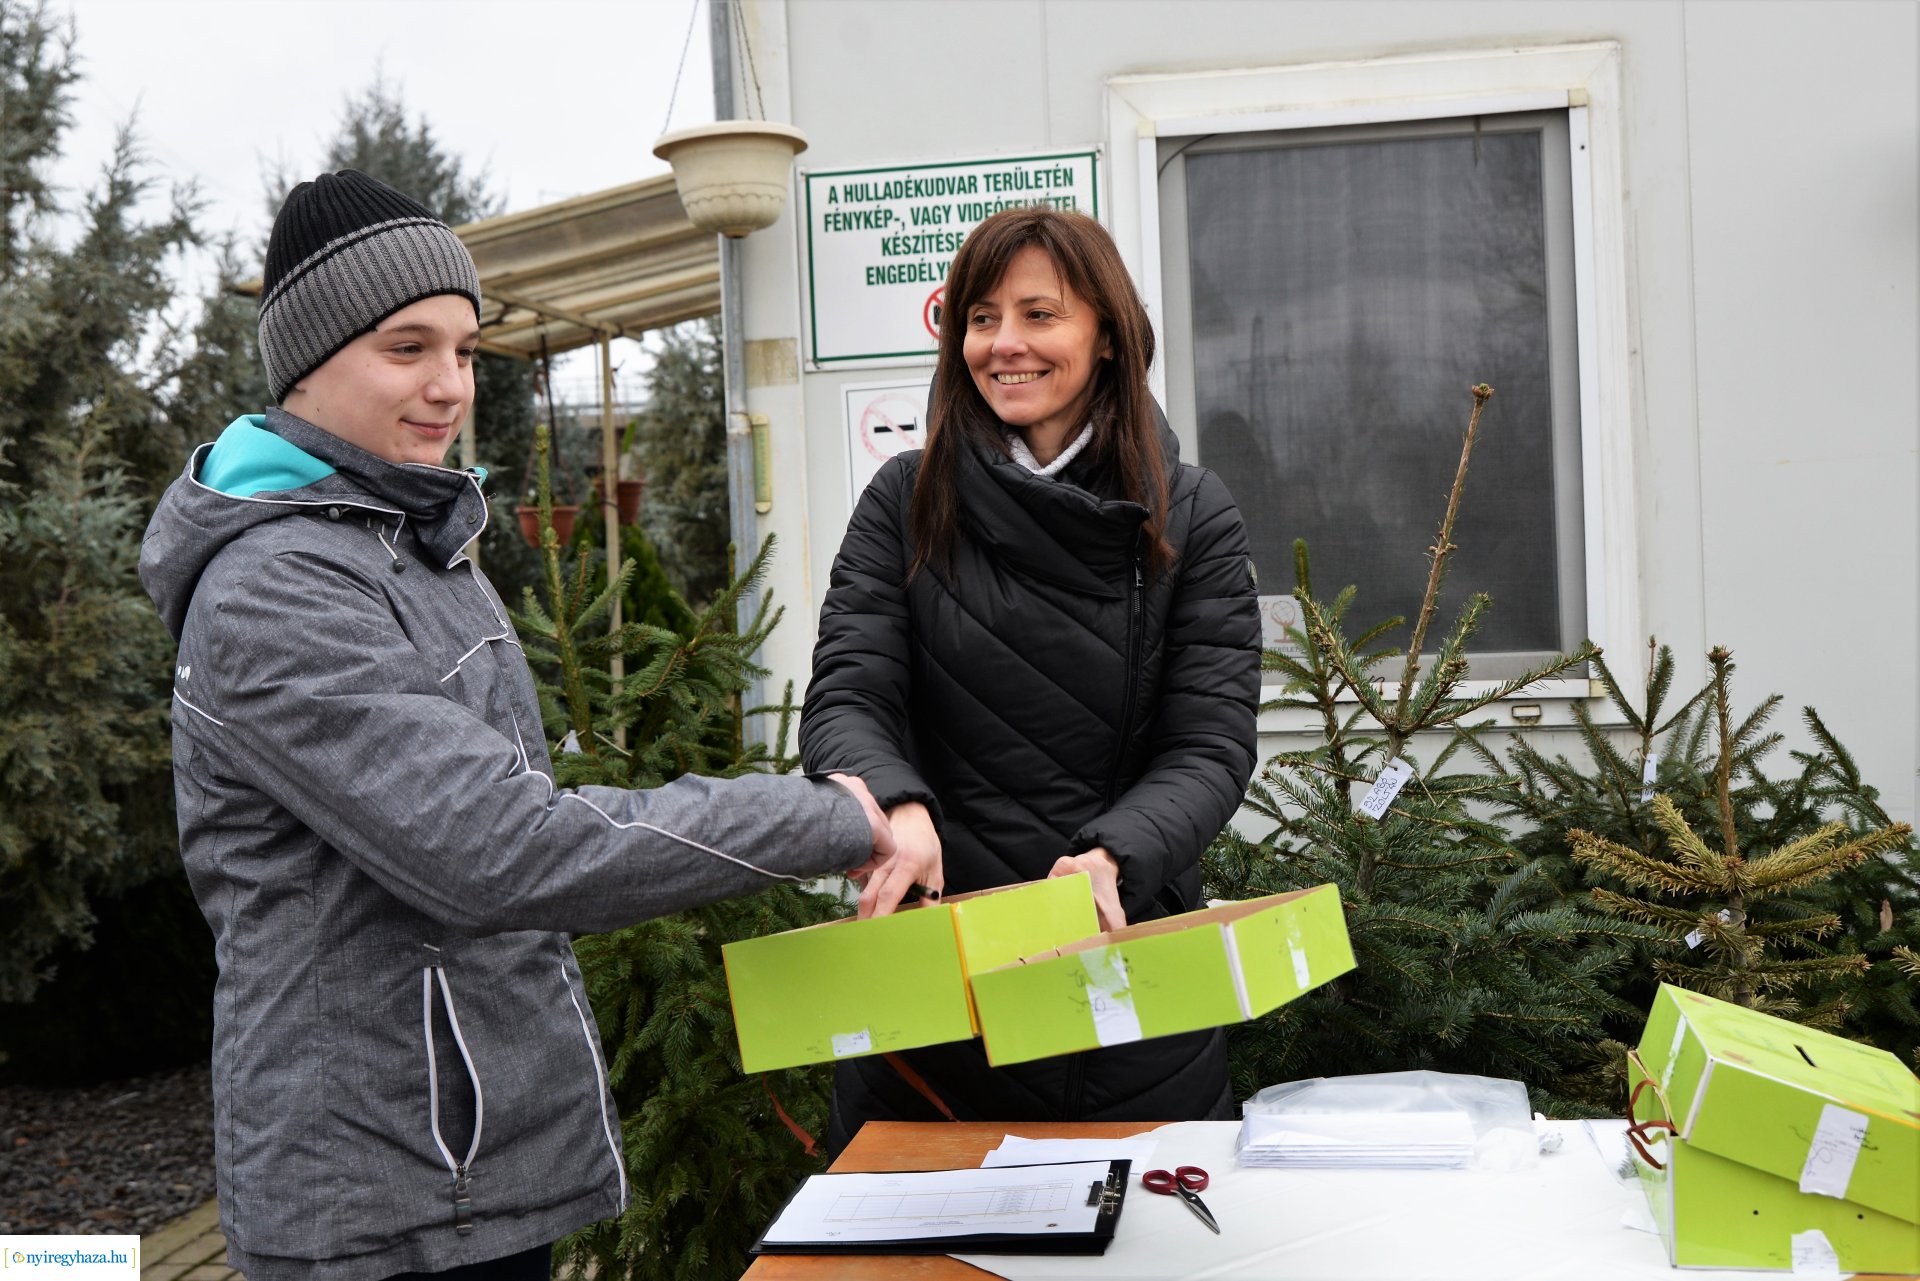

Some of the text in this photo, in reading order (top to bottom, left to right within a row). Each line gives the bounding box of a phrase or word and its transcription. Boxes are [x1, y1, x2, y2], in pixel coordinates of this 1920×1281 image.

[828, 164, 1074, 204] A HULLADÉKUDVAR TERÜLETÉN
[824, 204, 905, 233] FÉNYKÉP-,
[911, 204, 951, 226] VAGY
[881, 228, 965, 257] KÉSZÍTÉSE
